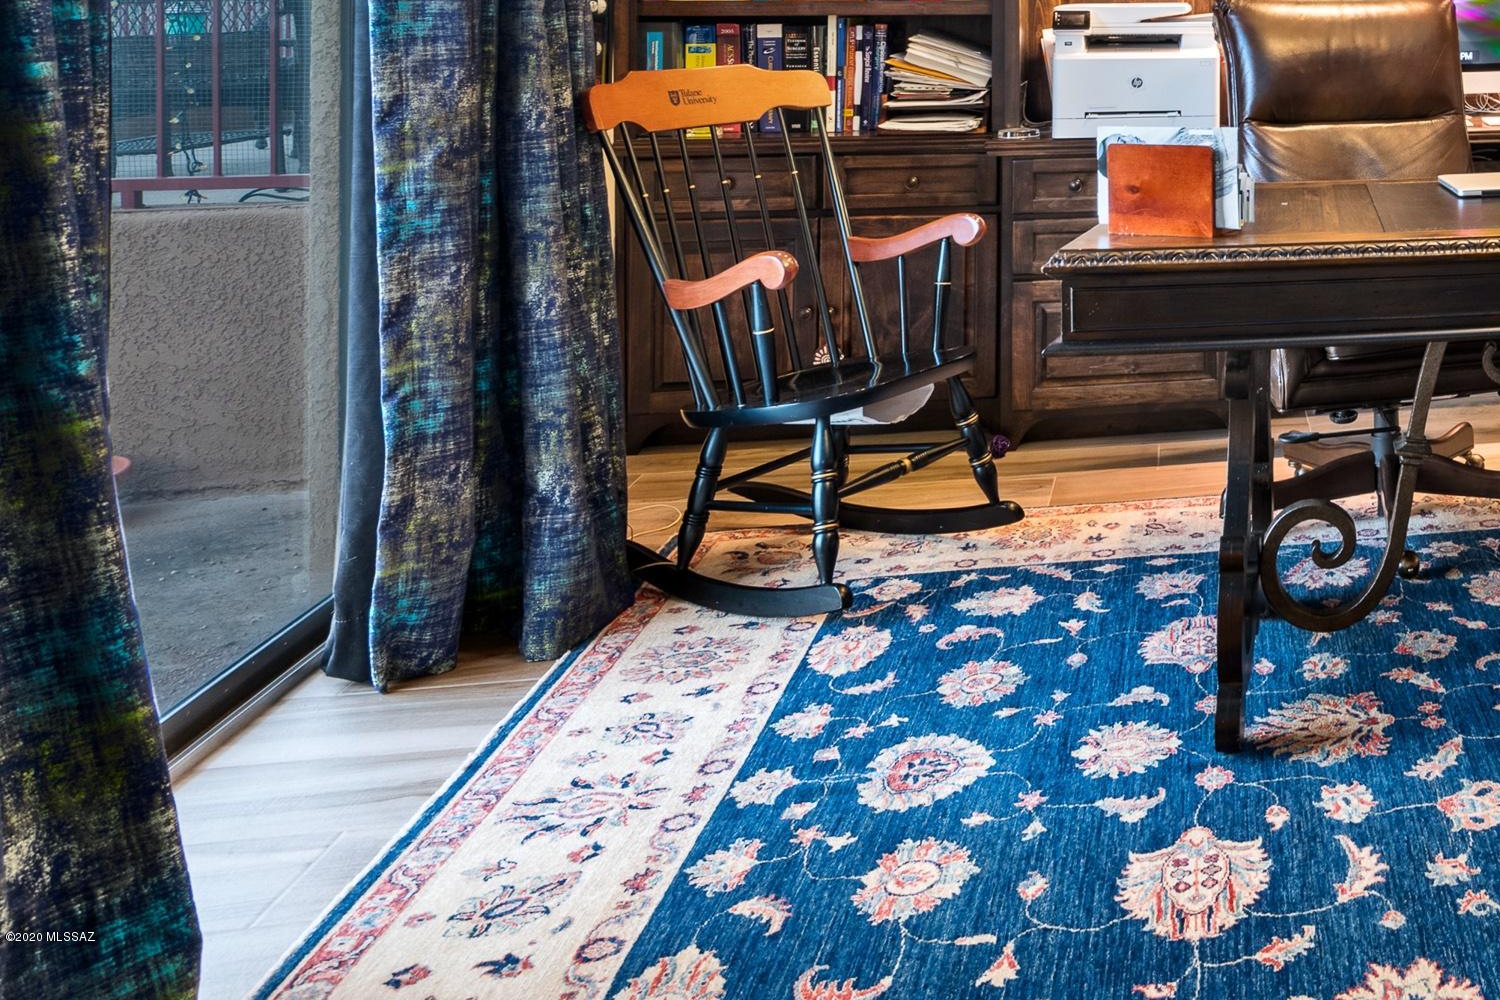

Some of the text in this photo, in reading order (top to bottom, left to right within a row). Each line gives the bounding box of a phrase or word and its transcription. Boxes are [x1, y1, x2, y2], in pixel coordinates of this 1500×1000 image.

[1460, 52, 1473, 60] PM
[1131, 77, 1143, 88] hp
[679, 89, 702, 97] Tulane
[682, 96, 717, 105] University
